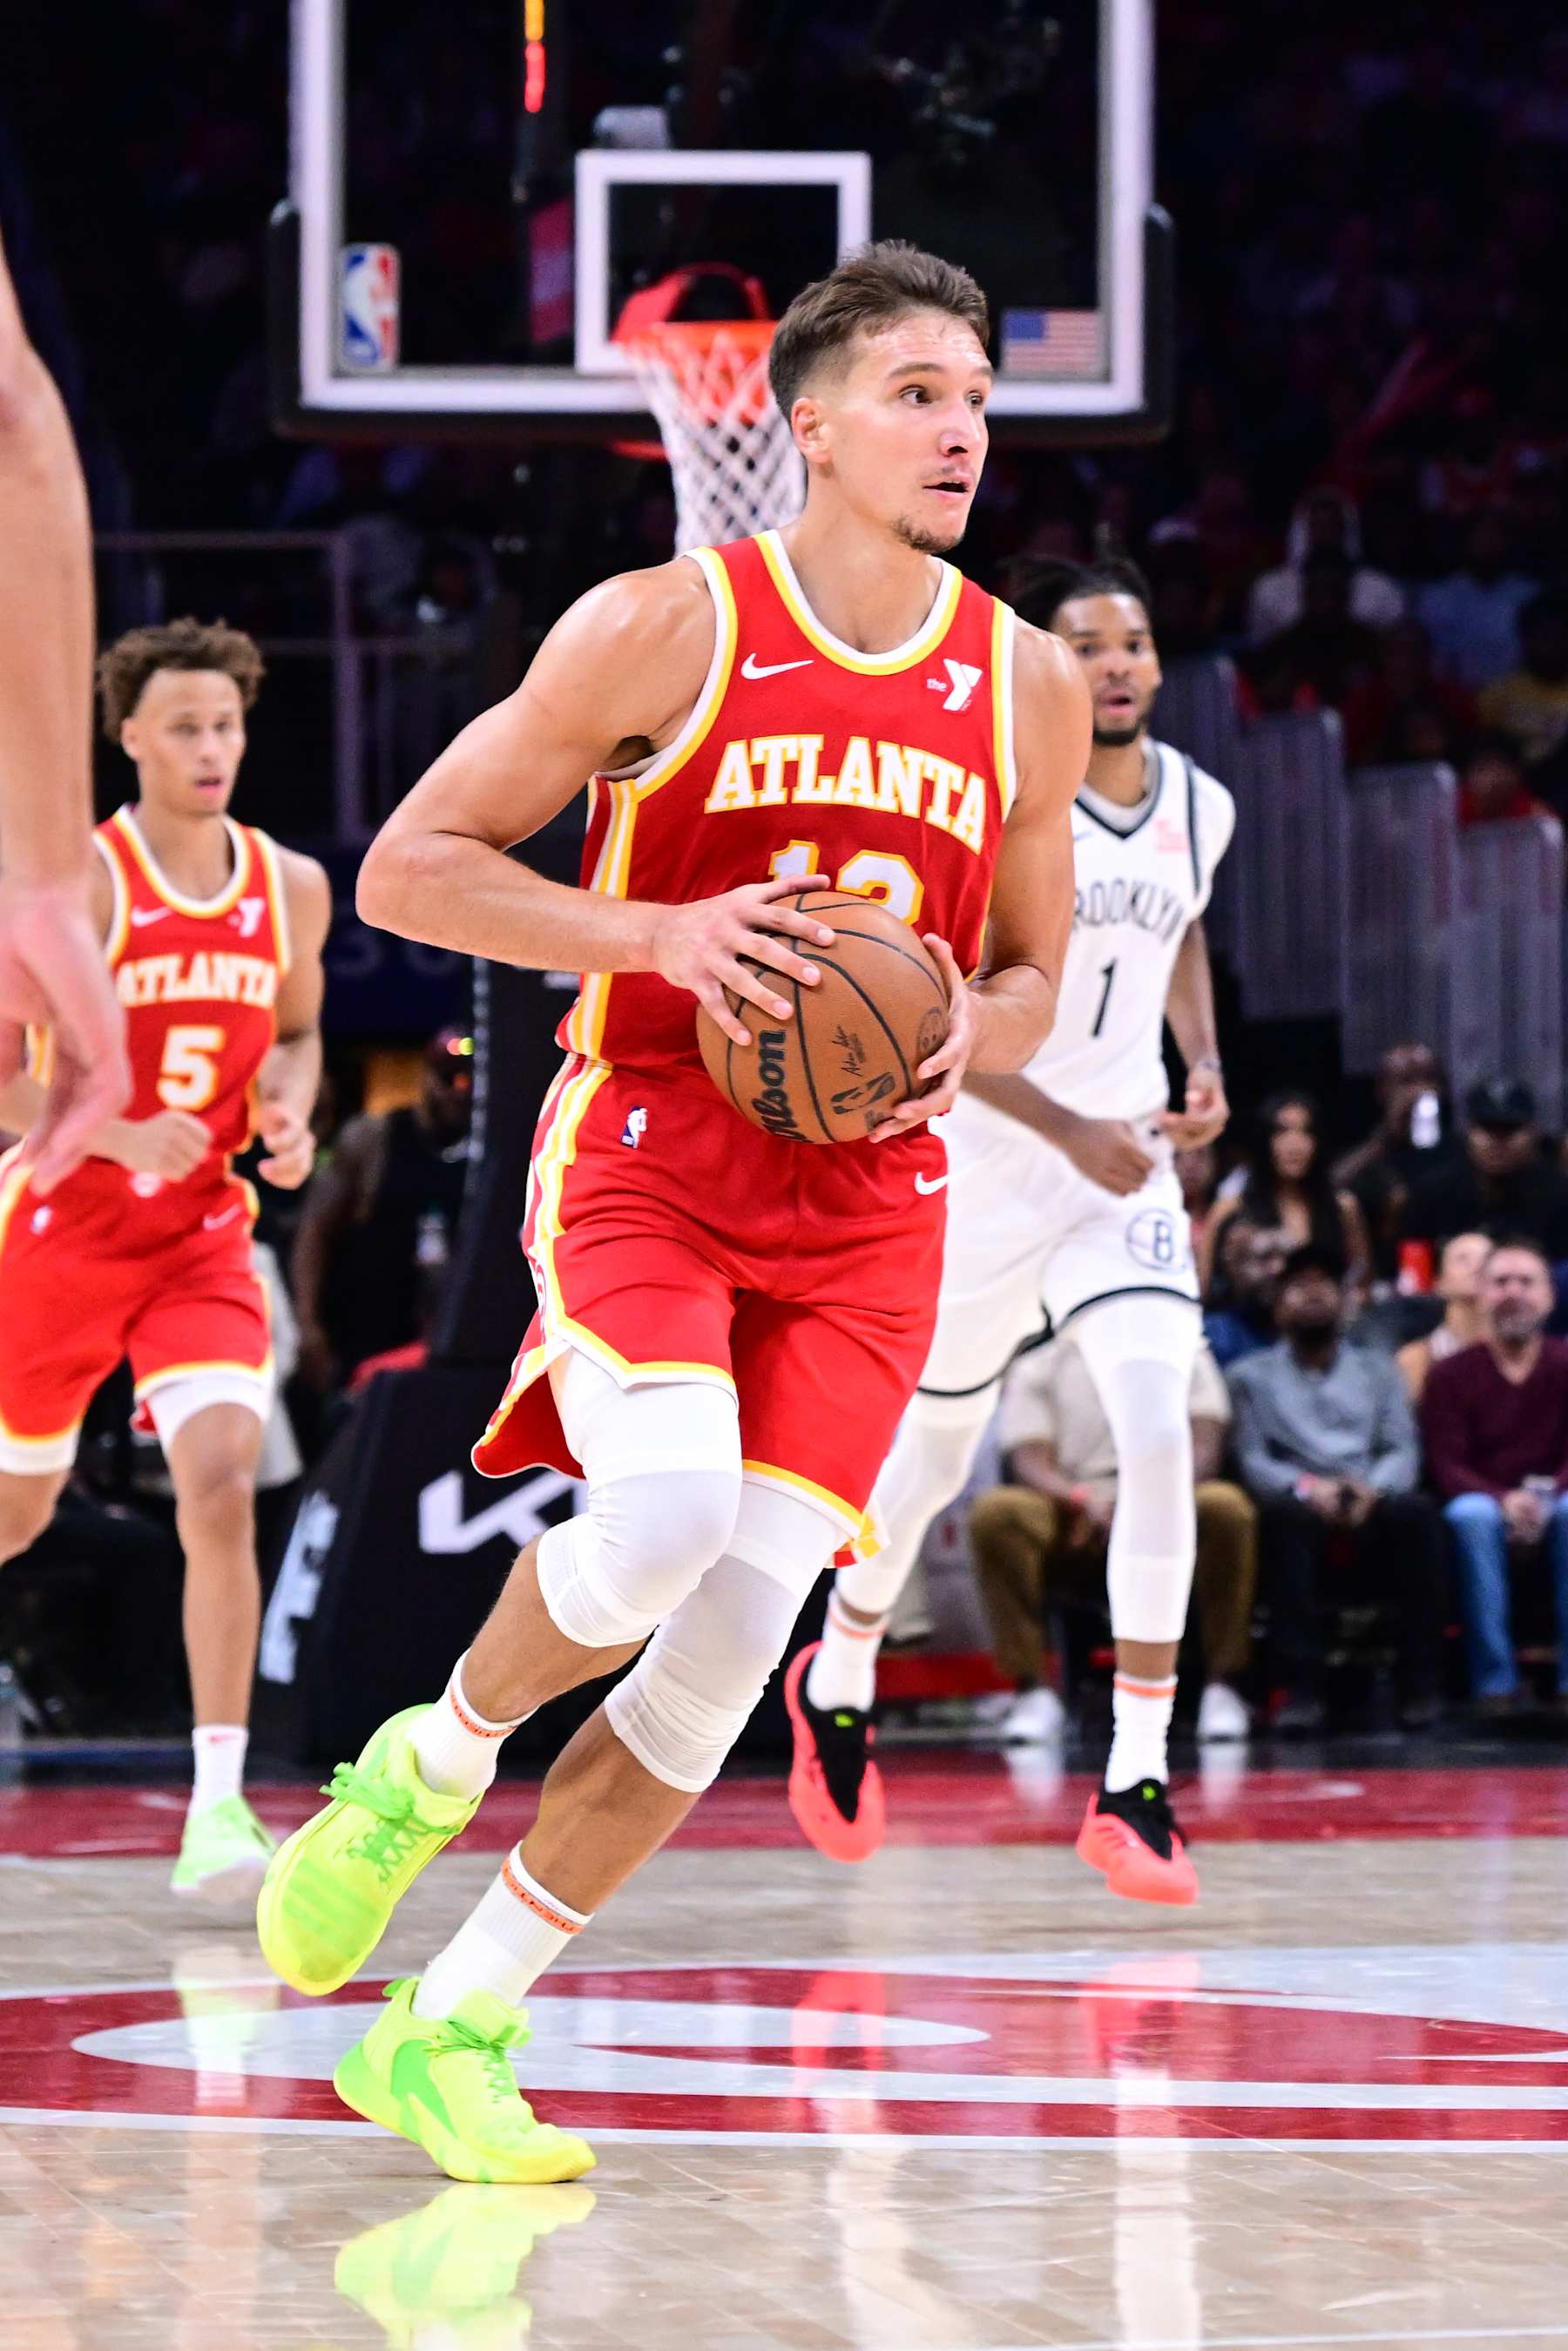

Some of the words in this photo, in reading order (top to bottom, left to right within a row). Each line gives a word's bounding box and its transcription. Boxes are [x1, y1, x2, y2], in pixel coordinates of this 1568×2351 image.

[704, 733, 986, 855] ATLANTA
[1072, 878, 1184, 944] ROOKLYN
[117, 951, 278, 1009] ATLANTA
[1090, 956, 1119, 1039] 1
[156, 1023, 226, 1111] 5
